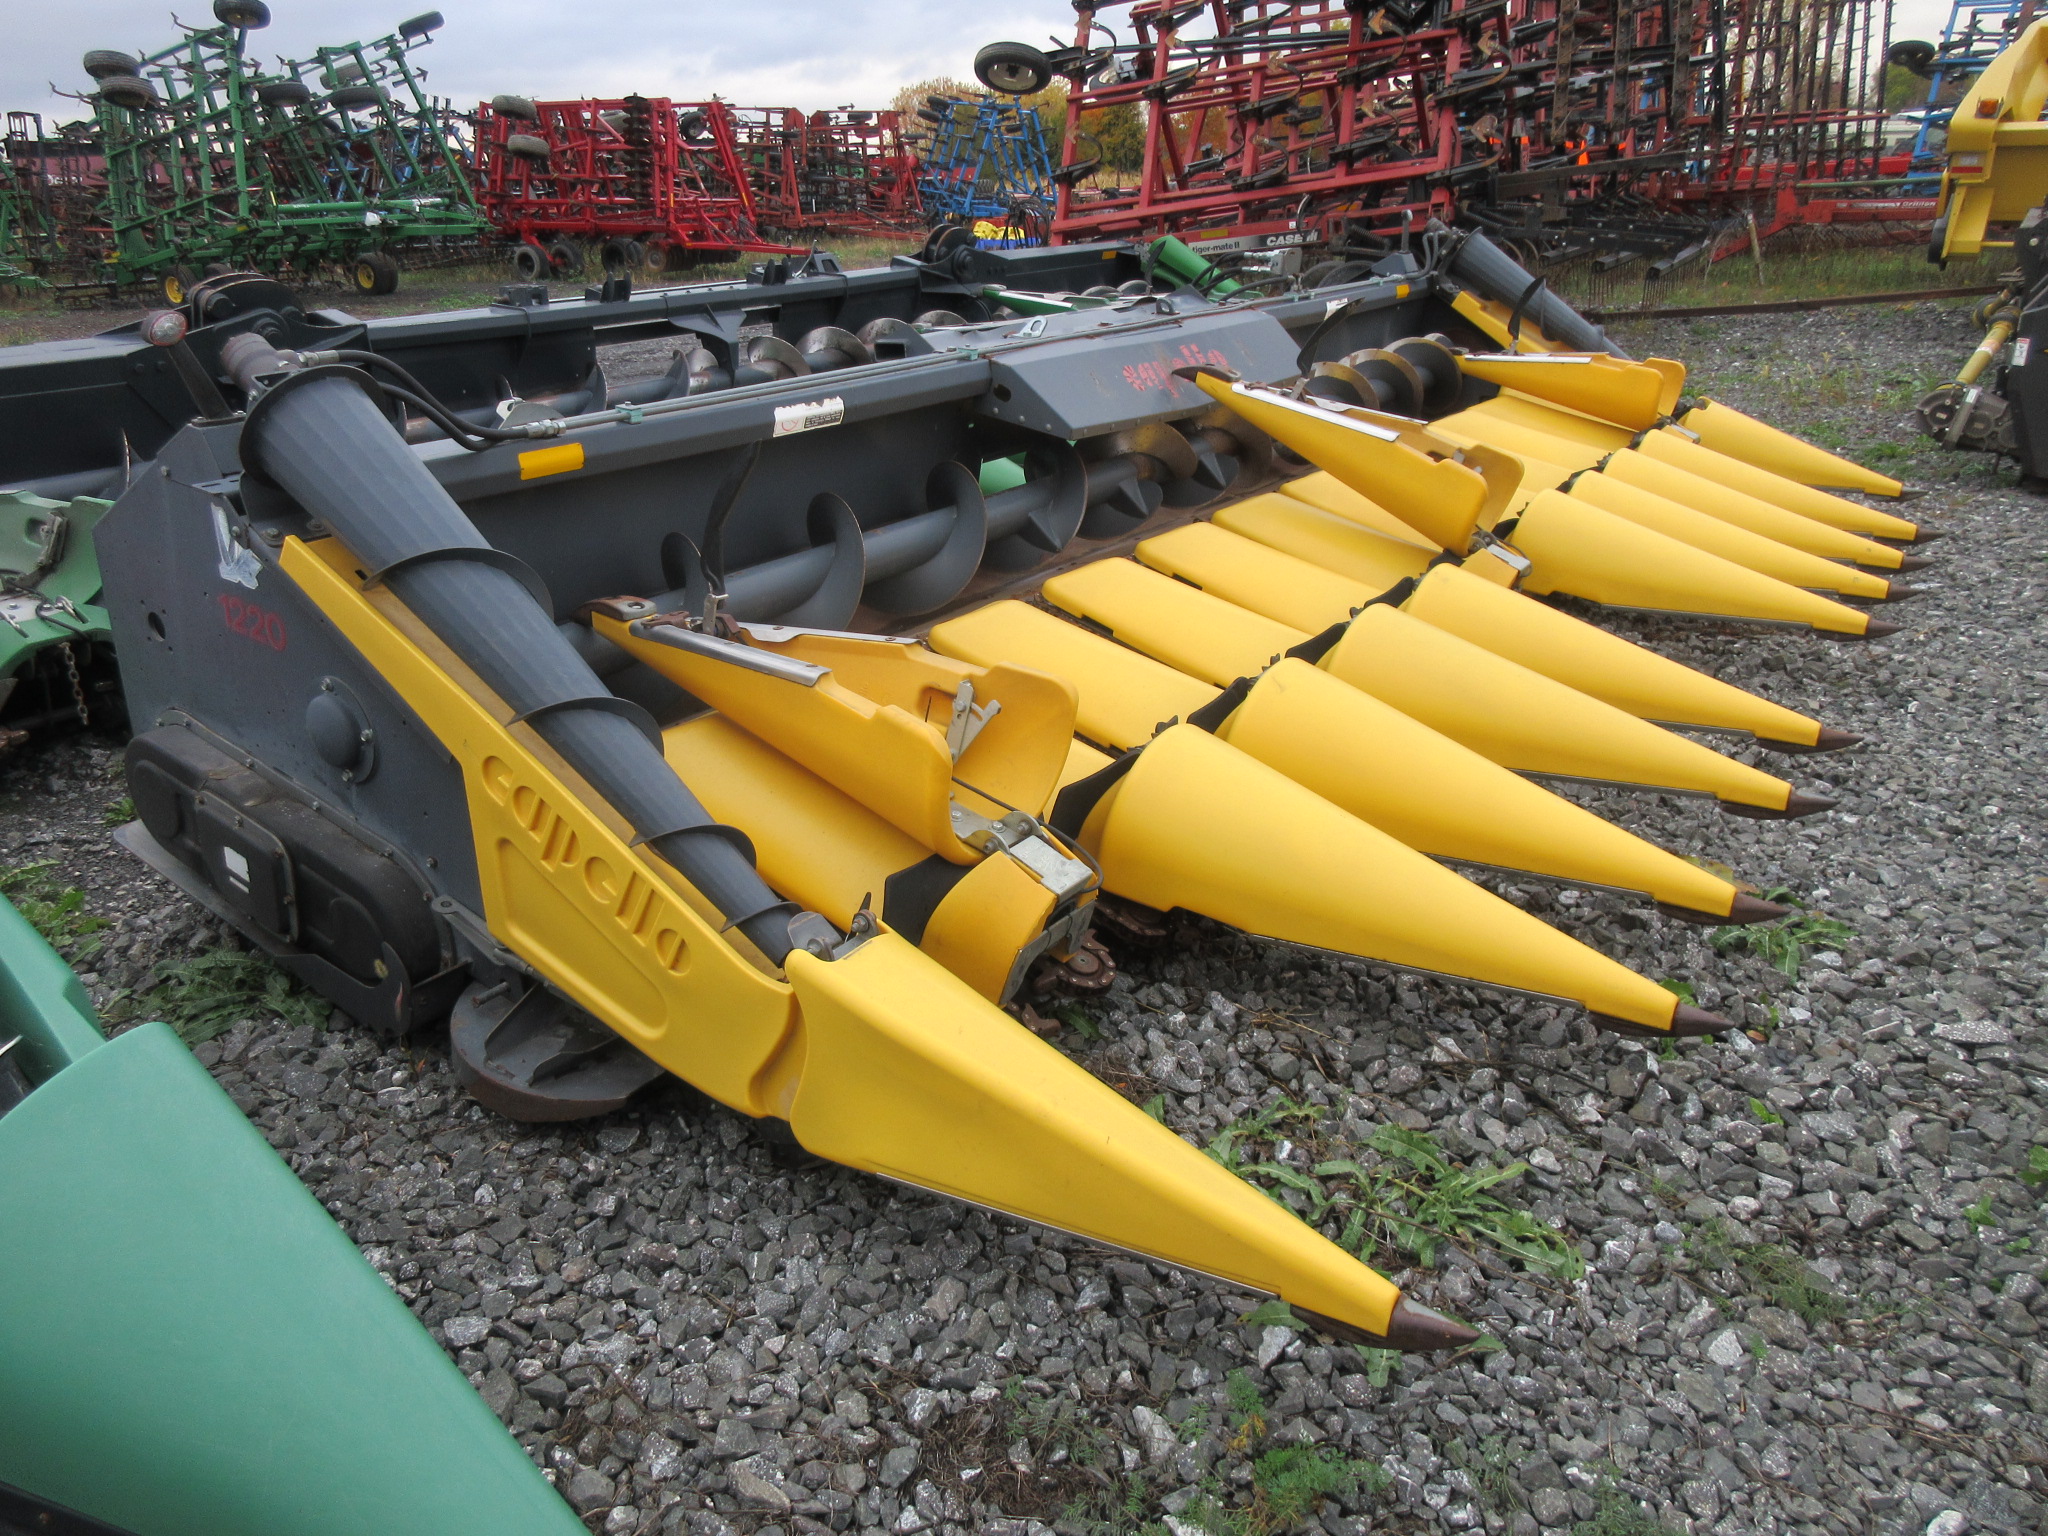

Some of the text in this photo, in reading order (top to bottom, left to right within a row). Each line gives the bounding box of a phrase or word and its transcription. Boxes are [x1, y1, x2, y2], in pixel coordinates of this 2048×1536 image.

[1266, 234, 1303, 246] CASE
[1192, 242, 1234, 254] tiger-mate
[217, 593, 288, 652] 1220
